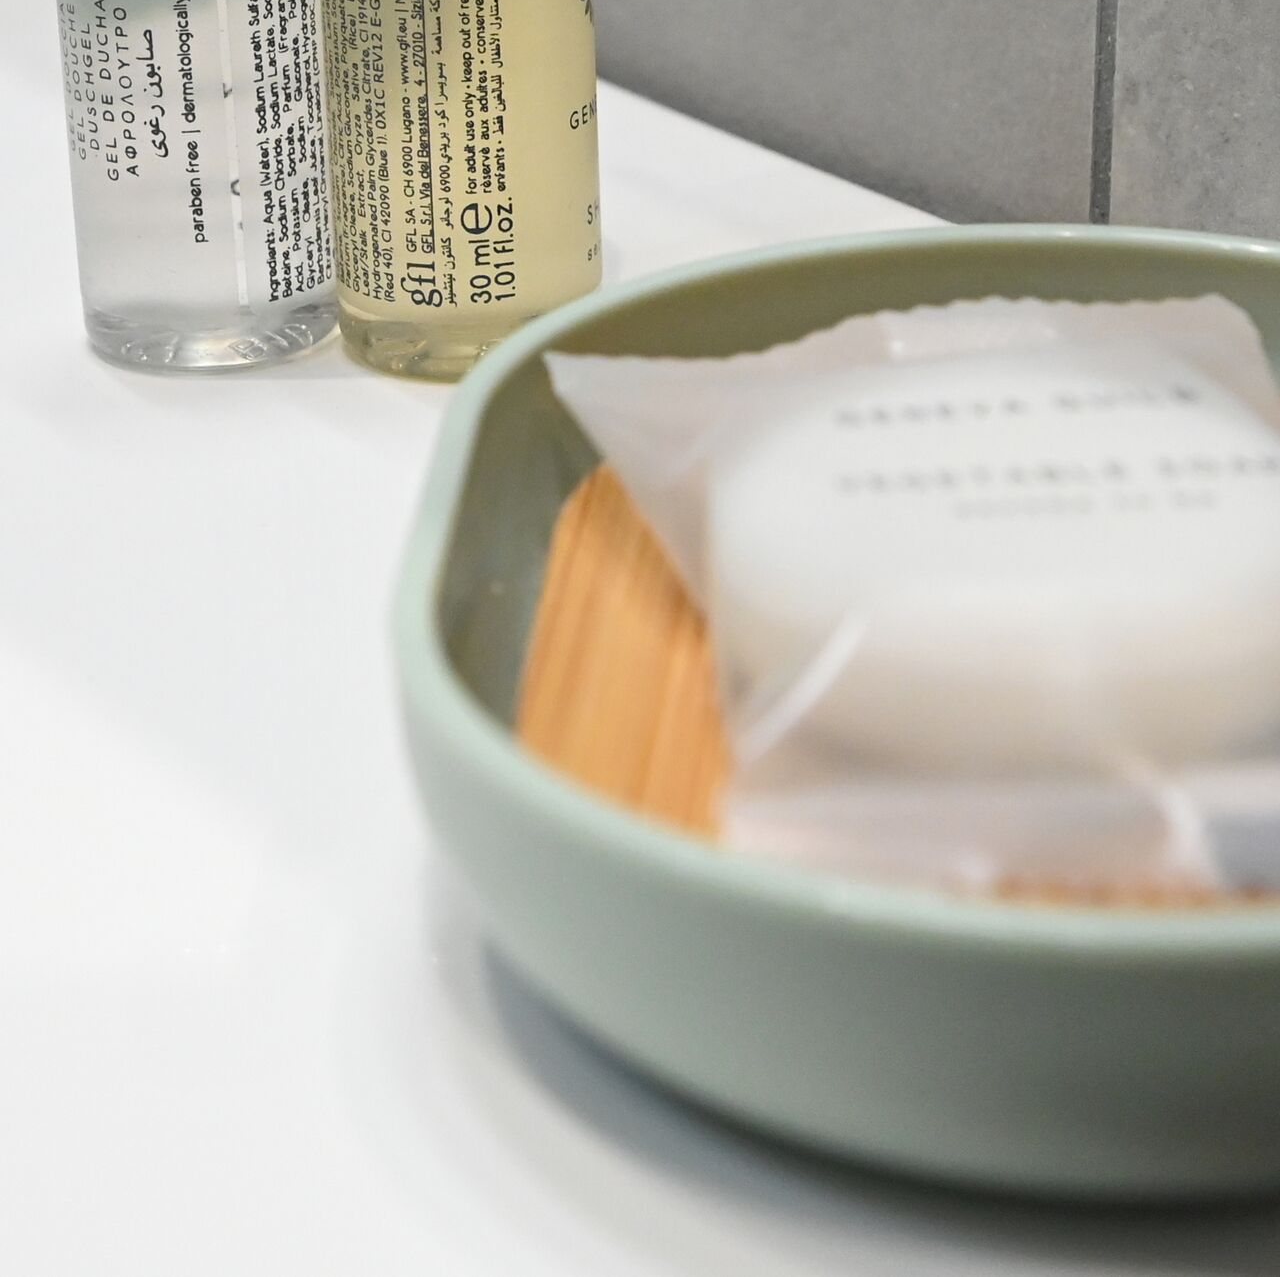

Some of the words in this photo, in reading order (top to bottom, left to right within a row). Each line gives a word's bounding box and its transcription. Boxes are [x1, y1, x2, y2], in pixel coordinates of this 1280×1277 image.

[359, 28, 369, 43] CI
[457, 12, 470, 25] of
[66, 4, 82, 102] DOUCHE
[250, 30, 264, 83] Laureth
[265, 24, 278, 78] Lactate,
[396, 17, 410, 85] www.gfl.eu
[458, 28, 471, 49] out
[360, 46, 371, 95] Citrate,
[370, 33, 384, 83] REV12
[461, 51, 475, 82] keep
[80, 23, 100, 150] DUSCHGEL
[269, 81, 281, 129] Sodium
[461, 92, 477, 118] only
[475, 70, 488, 113] adultes
[101, 94, 115, 122] DE
[254, 86, 268, 134] Sodium
[401, 96, 414, 143] Lugano
[363, 98, 376, 166] Glycerides
[465, 120, 475, 141] use
[480, 118, 490, 140] aux
[185, 140, 200, 173] free
[256, 137, 272, 186] (Water),
[272, 134, 285, 191] Chloride,
[377, 149, 389, 182] (Blue
[401, 145, 414, 176] 6900
[463, 144, 477, 173] adult
[494, 147, 506, 192] enfants
[366, 169, 377, 201] Palm
[403, 179, 415, 198] CH
[465, 176, 477, 194] for
[188, 177, 209, 243] paraben
[263, 189, 276, 224] Aqua
[277, 195, 289, 242] Sodium
[379, 184, 391, 226] 42090
[405, 208, 416, 225] SA
[381, 229, 392, 243] CI
[405, 227, 417, 253] GFL
[421, 228, 433, 254] GFL
[491, 196, 514, 254] fl.oz.
[264, 228, 281, 302] Ingredients:
[367, 203, 382, 300] Hydrogenated
[381, 246, 394, 269] 40),
[467, 239, 491, 266] ml
[281, 246, 293, 298] Betaine,
[383, 272, 395, 302] (Red
[400, 261, 443, 308] gfl
[469, 274, 492, 304] 30
[493, 261, 516, 301] 1.01
